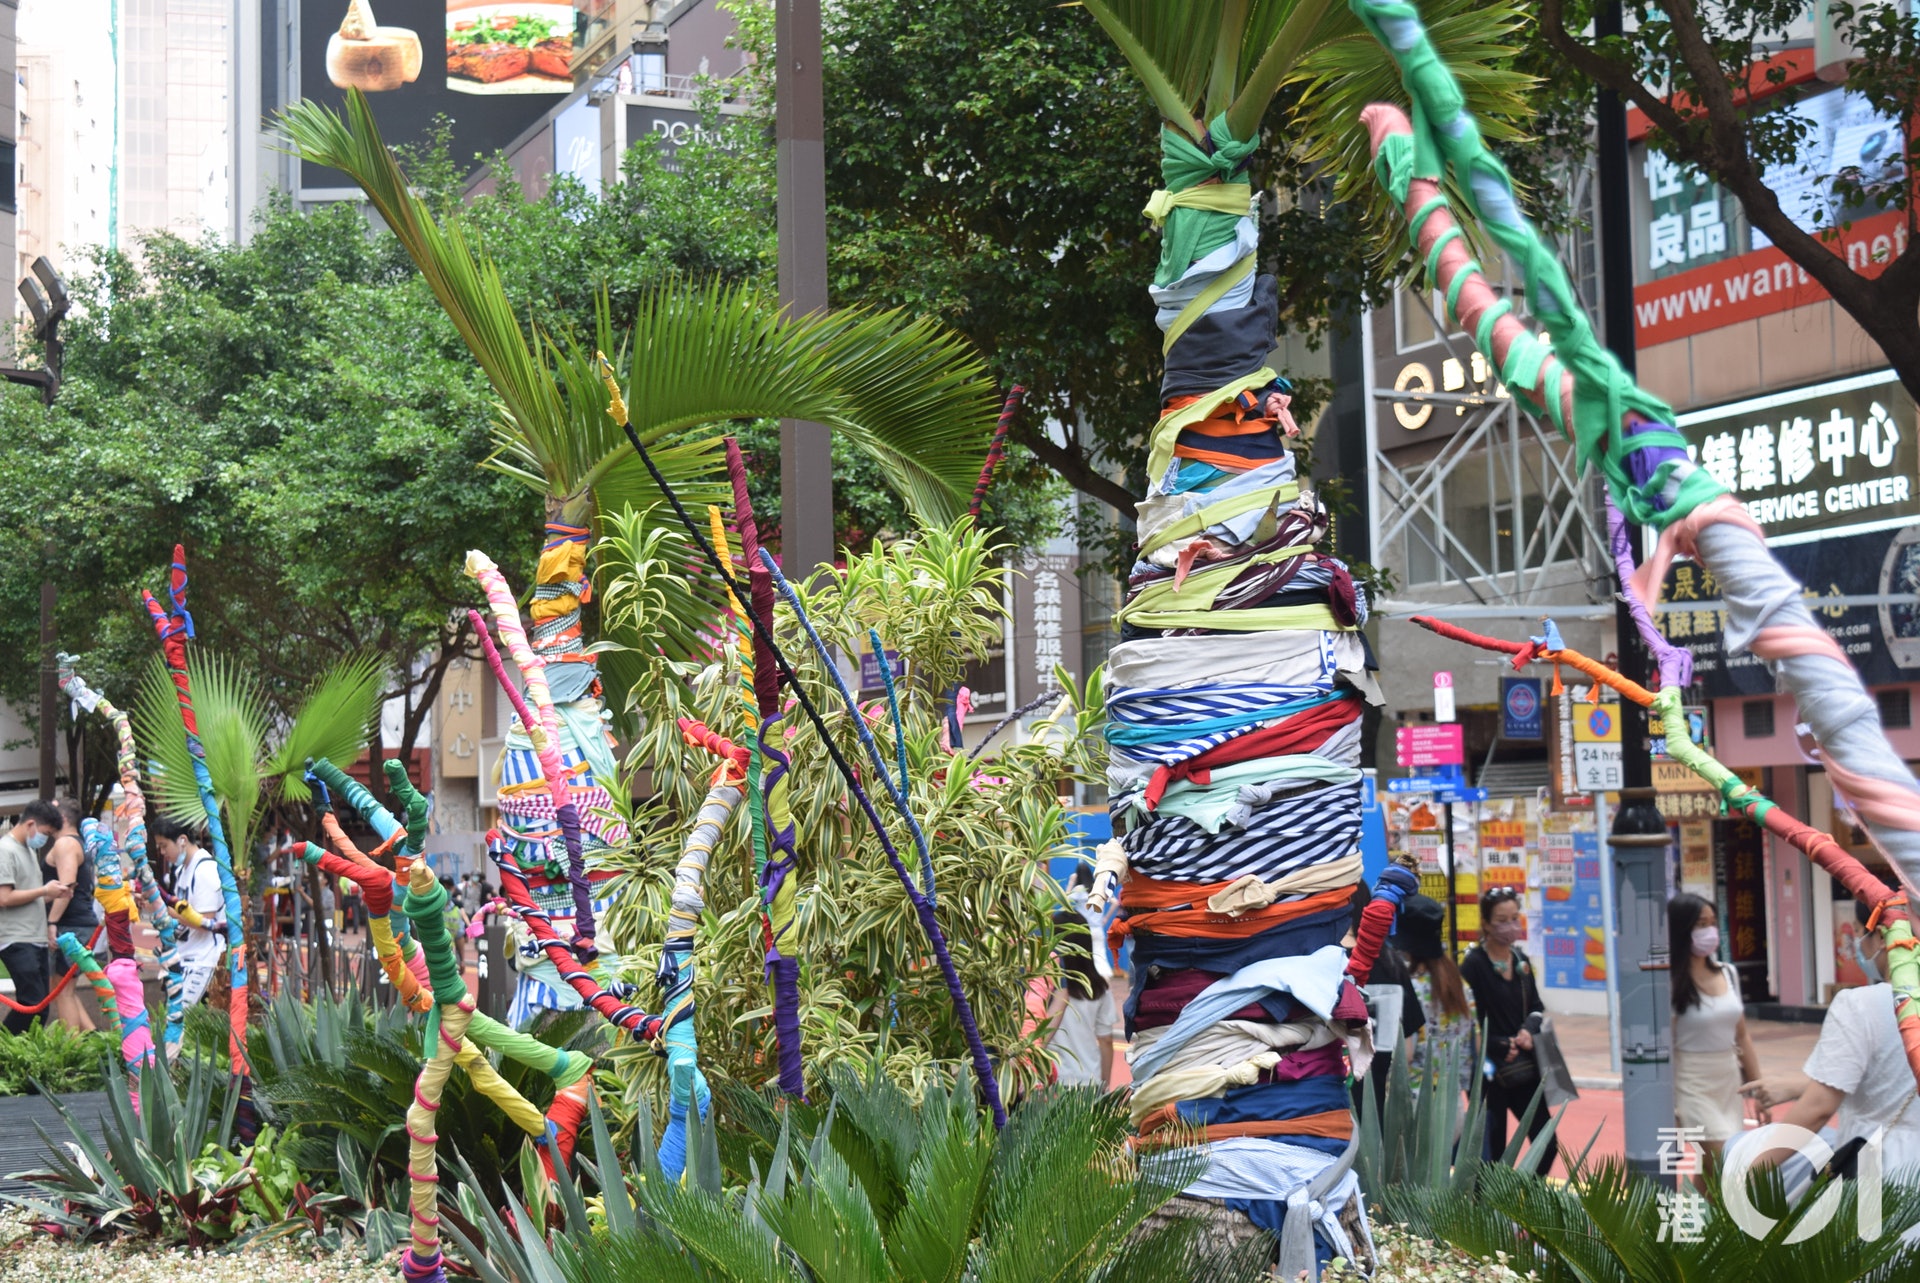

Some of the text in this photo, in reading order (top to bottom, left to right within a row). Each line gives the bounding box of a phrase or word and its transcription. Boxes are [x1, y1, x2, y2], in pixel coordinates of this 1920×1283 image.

[1649, 200, 1726, 270] 良品
[1687, 401, 1900, 493] 錶維修中心
[1824, 475, 1910, 513] CENTER
[1582, 749, 1622, 761] 24 hrs
[1587, 767, 1618, 784] 全日
